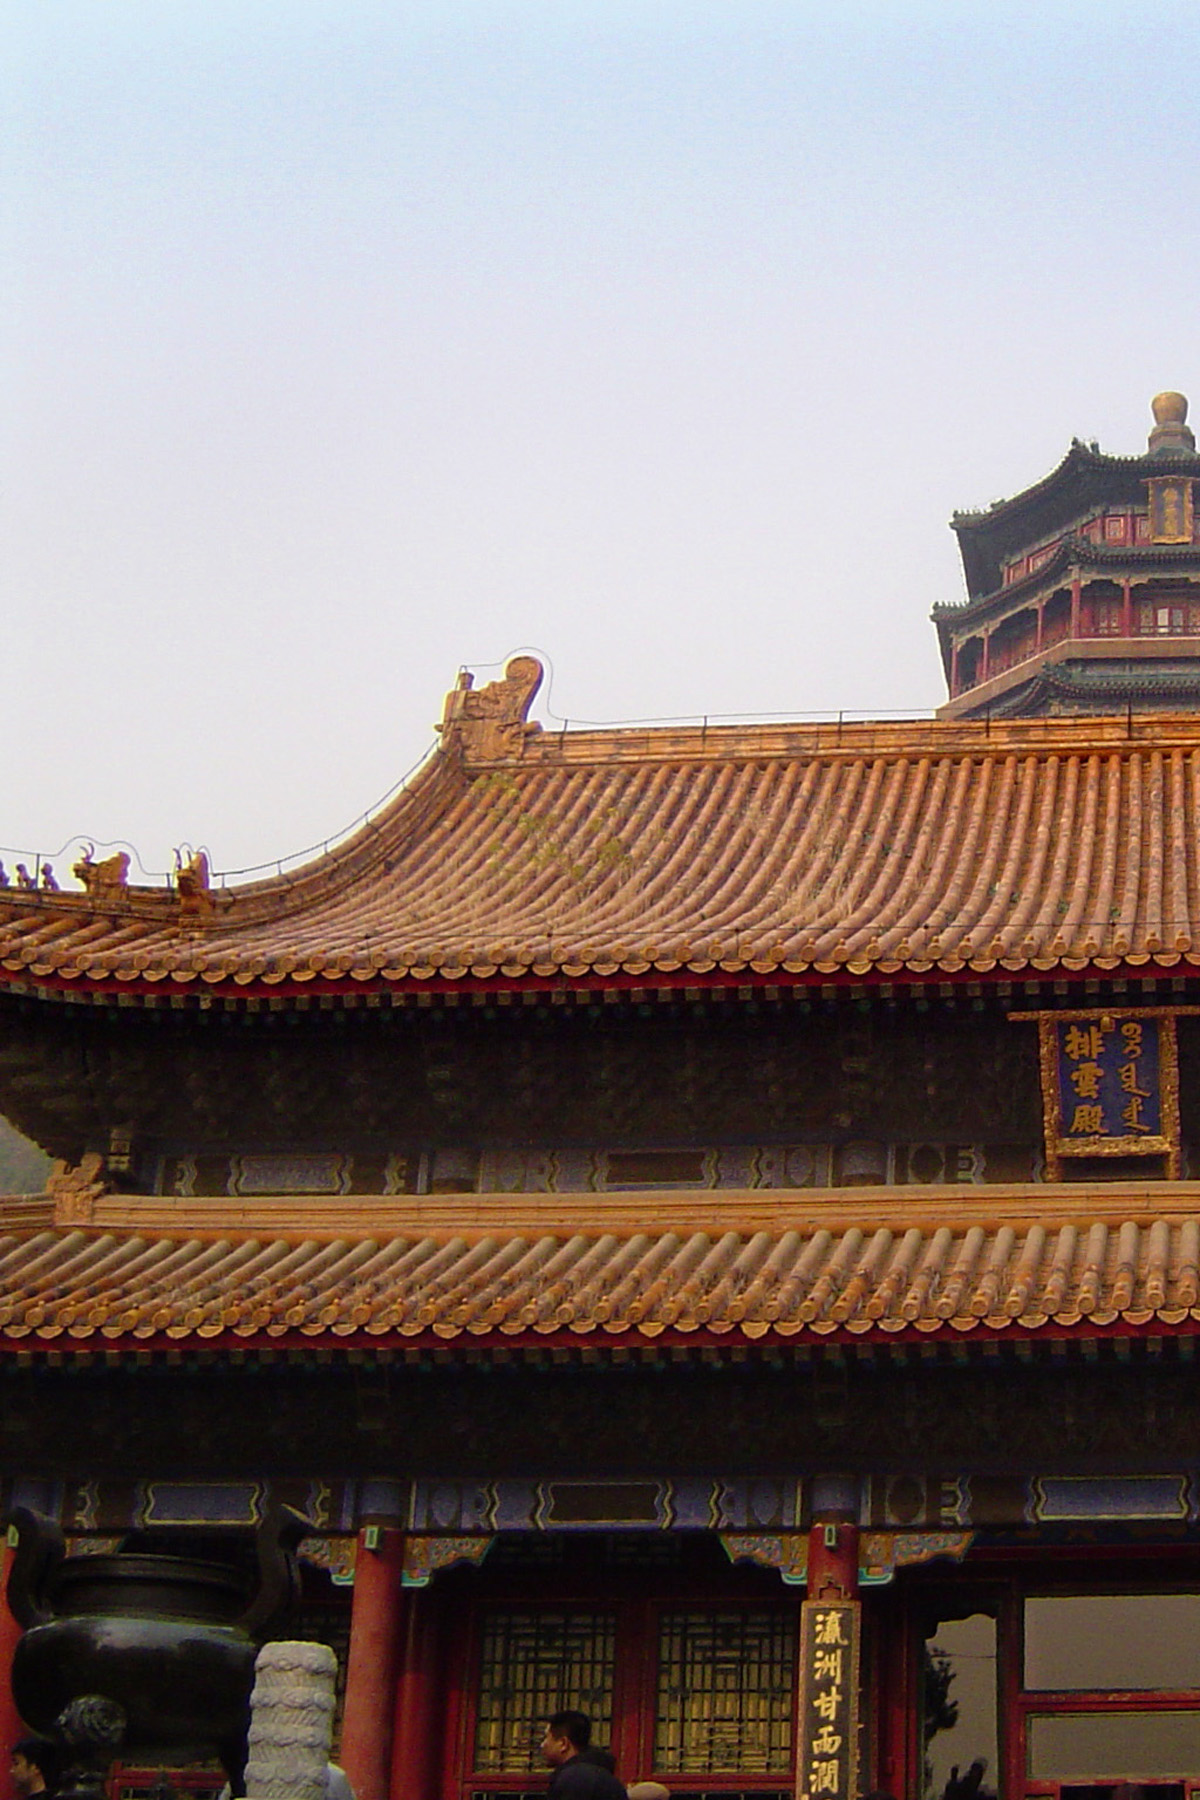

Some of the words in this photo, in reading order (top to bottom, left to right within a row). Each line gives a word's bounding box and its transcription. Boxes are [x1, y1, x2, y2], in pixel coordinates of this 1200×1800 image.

[1064, 1025, 1109, 1134] 排雲殿
[809, 1611, 848, 1793] 瀛洲甘雨潤
